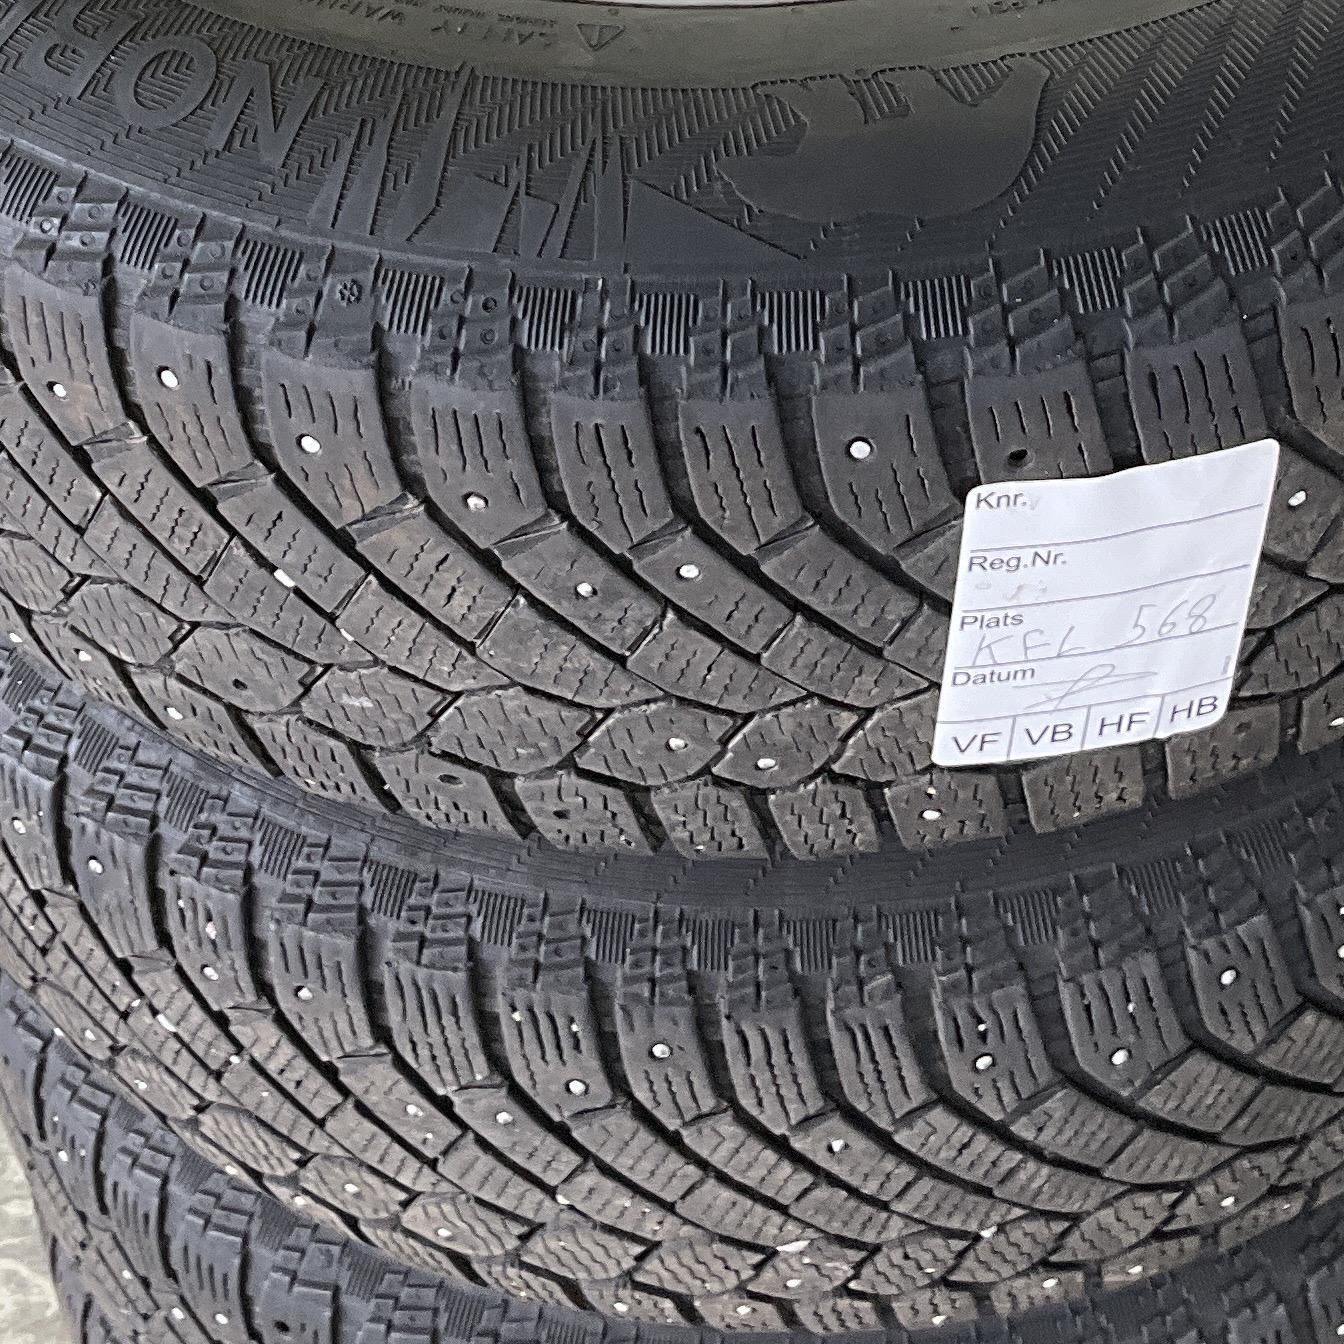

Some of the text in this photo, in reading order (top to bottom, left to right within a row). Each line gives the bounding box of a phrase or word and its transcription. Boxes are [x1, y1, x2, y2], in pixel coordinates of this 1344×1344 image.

[975, 491, 1029, 511] Knr.
[959, 610, 1025, 632] Plats
[1114, 593, 1219, 649] 568
[951, 665, 1036, 688] Datum
[952, 694, 1219, 754] VF VB HF HB
